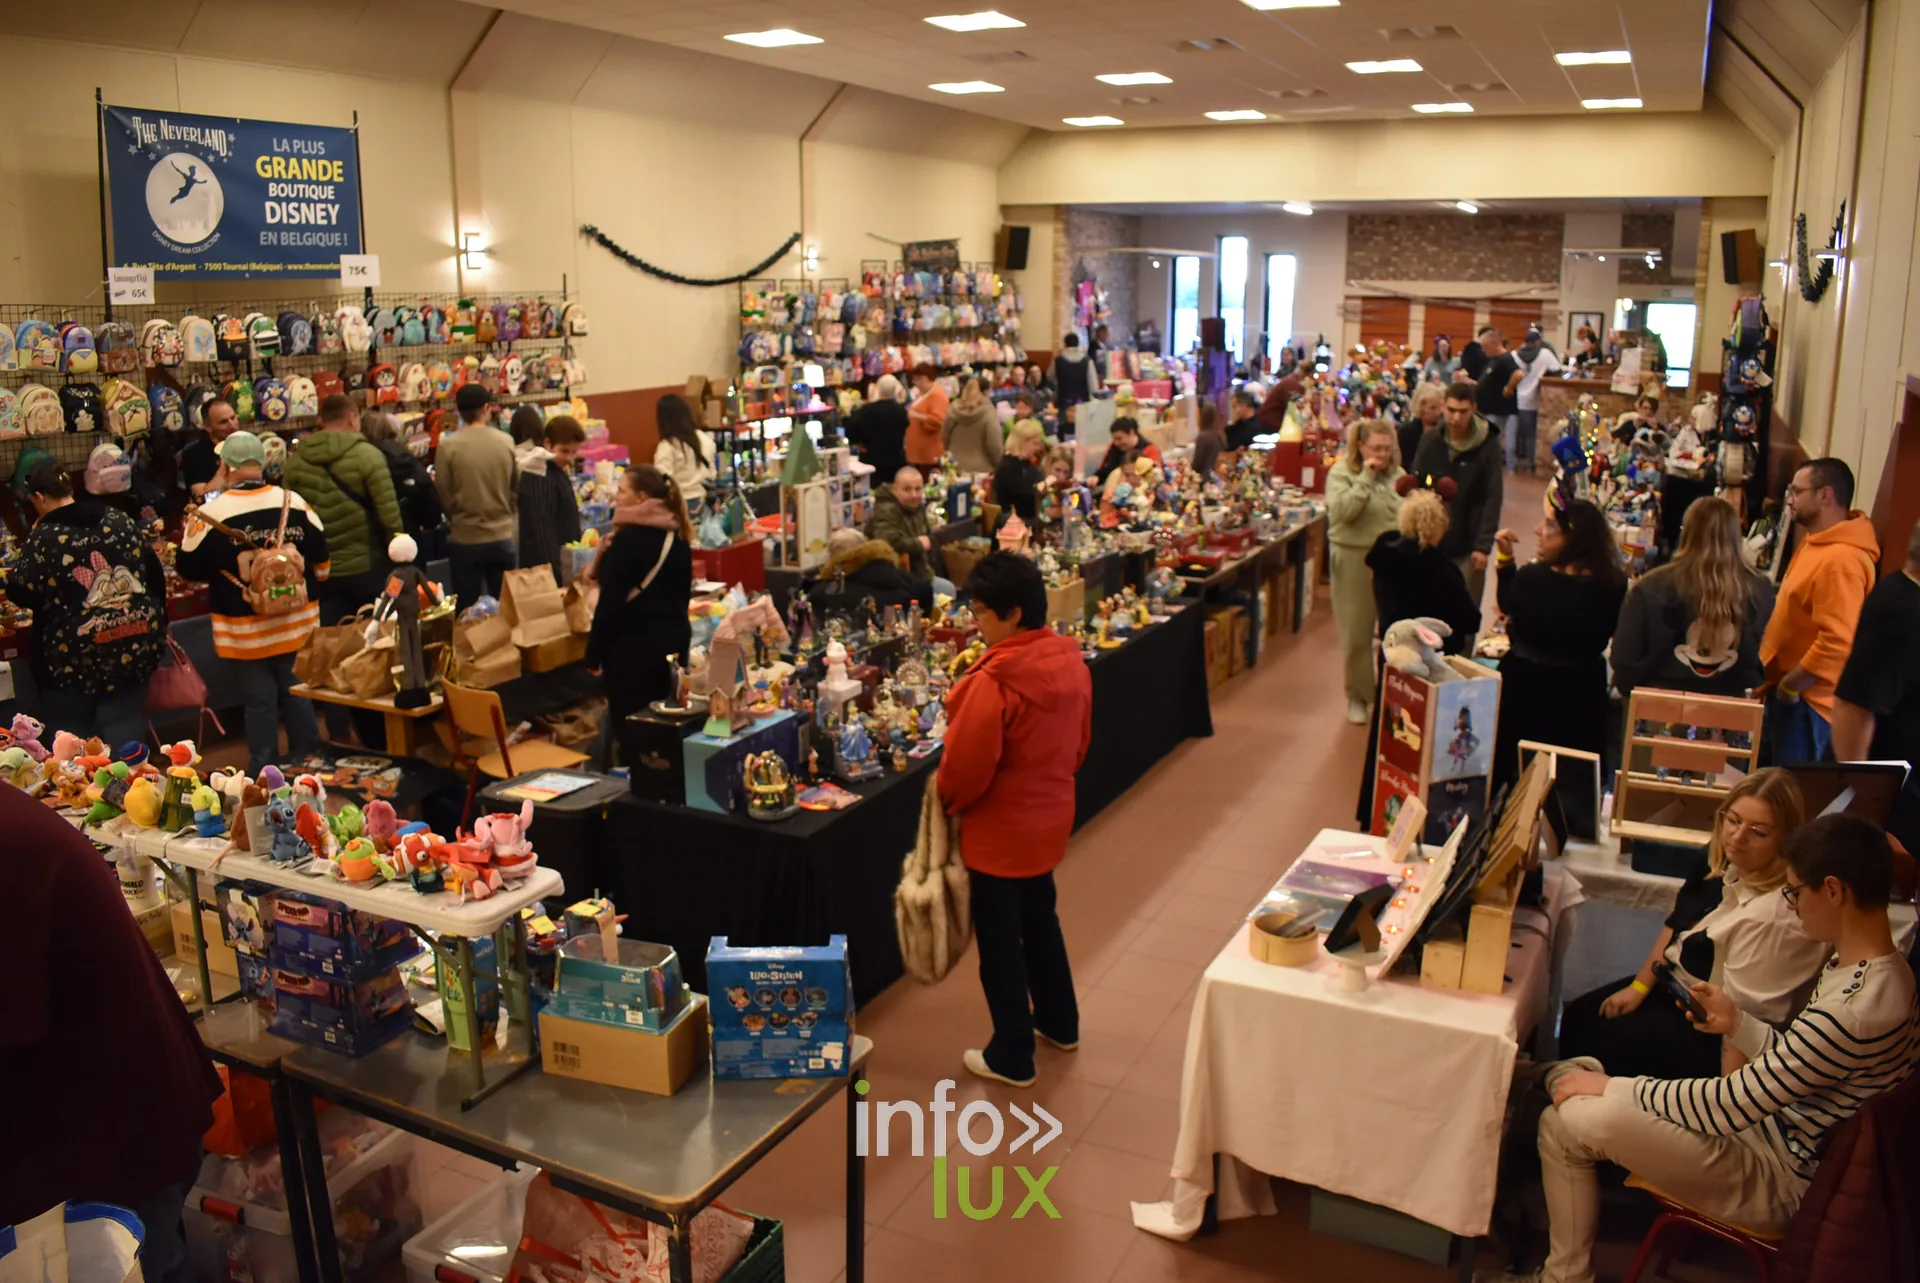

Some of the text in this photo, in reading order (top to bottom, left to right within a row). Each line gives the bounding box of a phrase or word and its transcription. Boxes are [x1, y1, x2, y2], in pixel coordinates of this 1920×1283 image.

[132, 116, 228, 157] THE NEVERLAND
[273, 138, 326, 155] LA PLUS
[255, 155, 344, 183] GRANDE
[268, 182, 335, 200] BOUTIQUE
[265, 201, 340, 225] DISNEY
[260, 231, 278, 245] EN
[280, 231, 342, 247] BELGIQUE
[165, 262, 196, 272] d'Argent
[204, 262, 222, 271] 7500
[223, 262, 249, 271] Tournai
[349, 266, 367, 275] 75€
[132, 289, 147, 297] 65€
